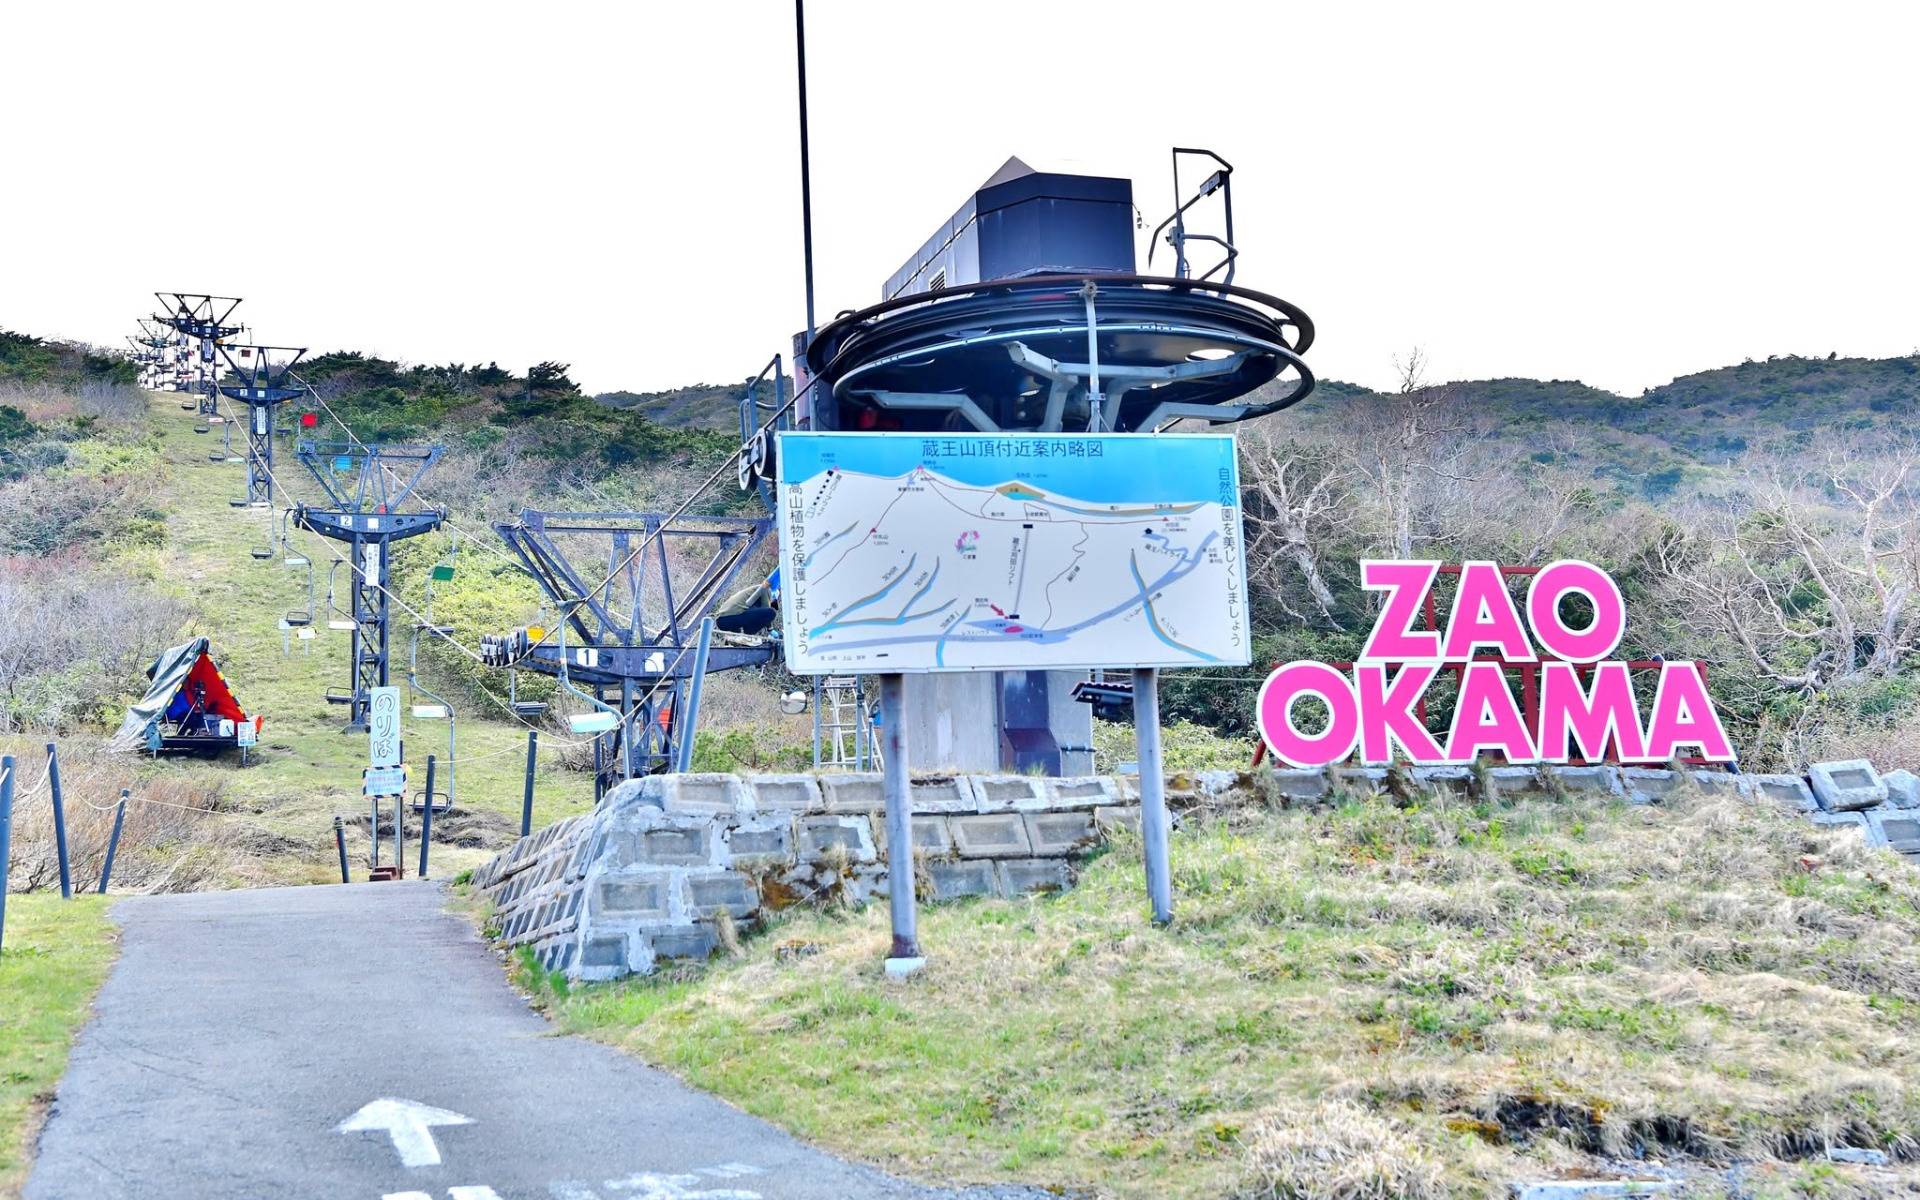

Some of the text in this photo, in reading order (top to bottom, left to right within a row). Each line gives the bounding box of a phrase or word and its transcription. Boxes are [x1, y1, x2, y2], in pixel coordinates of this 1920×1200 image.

[922, 440, 1103, 457] 蔵王山頂付近案内略図
[789, 480, 808, 654] 高山植物を保護しましょう
[1218, 467, 1240, 647] 自然公園を美しくしましょう
[1360, 559, 1626, 664] ZAO
[373, 693, 396, 759] のりば
[1256, 660, 1738, 768] OKAMA
